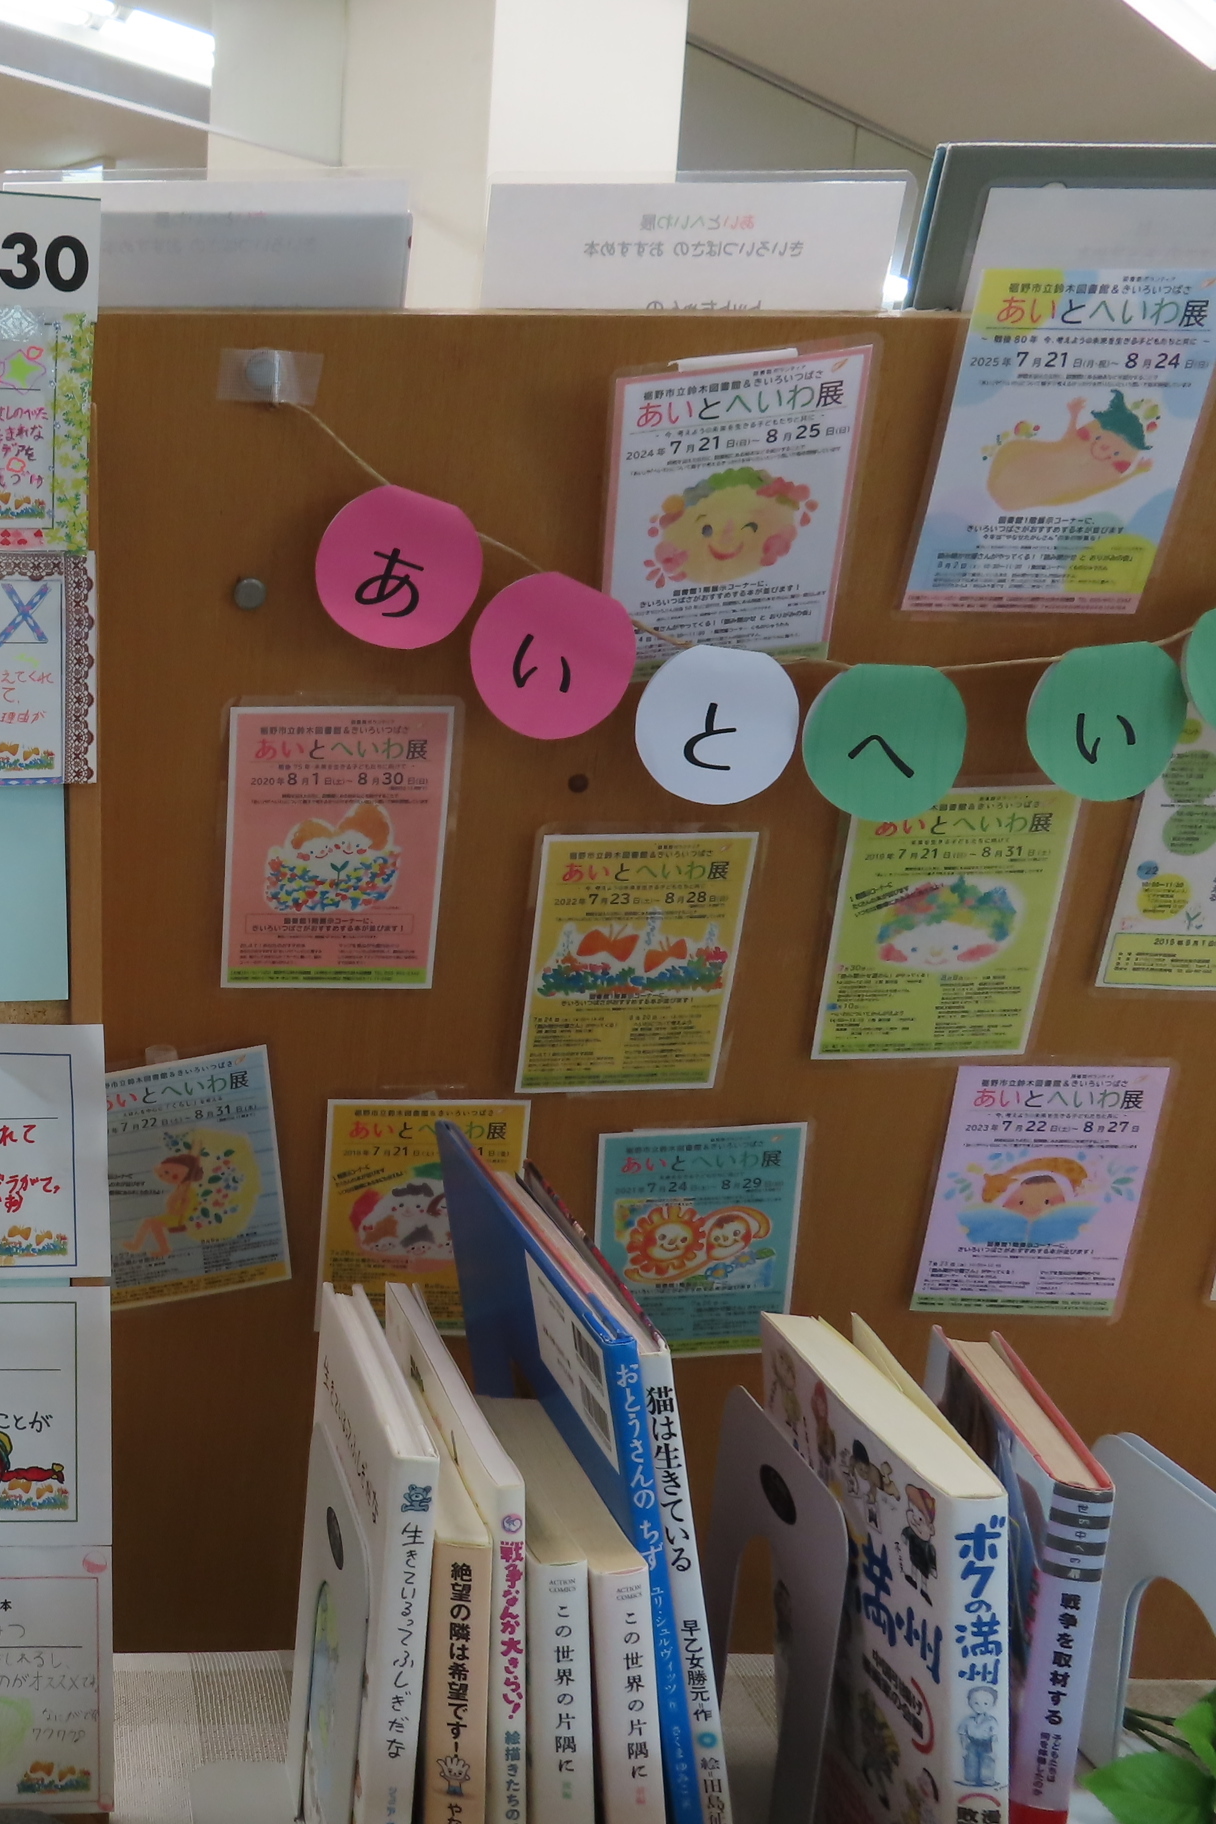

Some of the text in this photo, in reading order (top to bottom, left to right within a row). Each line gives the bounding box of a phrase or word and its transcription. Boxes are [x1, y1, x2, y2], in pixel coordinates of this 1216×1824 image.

[997, 296, 1209, 328] あいとへいわ展
[636, 380, 844, 428] あいとへいわ展
[354, 547, 425, 619] あ
[512, 634, 572, 693] い
[683, 702, 737, 771] と
[848, 734, 914, 778] へ
[1076, 713, 1136, 765] い
[255, 738, 428, 760] あいとへいわ展
[562, 861, 730, 881] あいとへいわ展
[348, 1121, 507, 1140] あいとへわ展
[621, 1151, 781, 1173] あいとへいわ展
[973, 1089, 1143, 1109] あいとへいわ展
[615, 1363, 664, 1572] おとうさんの ちず
[646, 1385, 692, 1573] 猫は生きている
[386, 1522, 425, 1760] 生きているってふしぎだな
[446, 1562, 473, 1760] 絶望の隣は希望です!
[955, 1514, 1006, 1685] ボクの満州
[1045, 1592, 1082, 1726] 戦争を取材する
[554, 1605, 576, 1774] この世界の片隅に
[623, 1612, 648, 1779] この世界の片隅に
